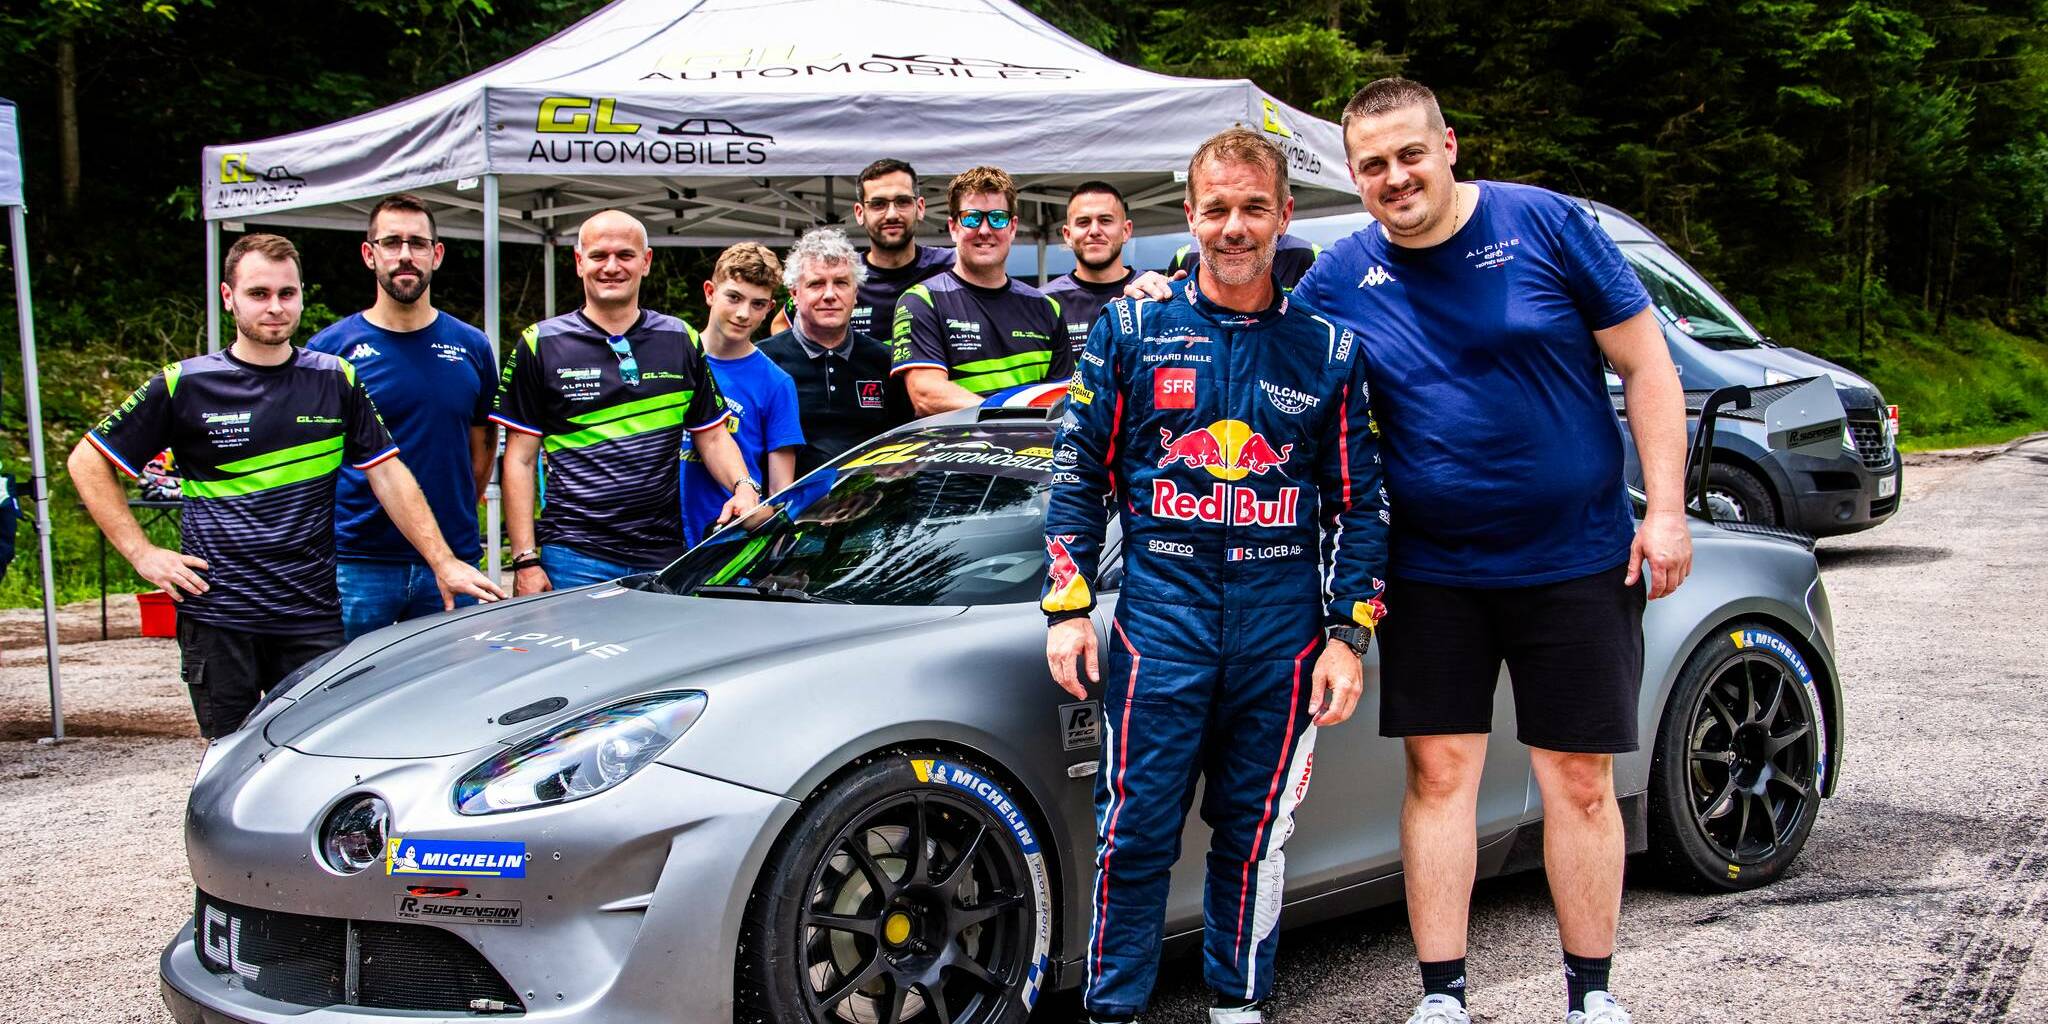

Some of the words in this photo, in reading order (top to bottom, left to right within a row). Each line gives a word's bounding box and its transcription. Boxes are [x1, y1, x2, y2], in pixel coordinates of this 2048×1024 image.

[639, 60, 1084, 81] AUTOMOBILES
[535, 96, 642, 134] GL
[1263, 98, 1291, 138] GL
[528, 139, 767, 165] AUTOMOBILES
[220, 152, 257, 184] GL
[1465, 238, 1520, 259] ALPINE
[950, 333, 981, 341] ALPINE
[430, 343, 467, 353] ALPINE
[1143, 352, 1182, 363] RICHARD
[1184, 354, 1212, 363] MILLE
[561, 382, 601, 390] ALPINE
[1068, 385, 1092, 399] ARDAHL
[1163, 379, 1194, 394] SFR
[1259, 379, 1320, 408] VULCANET
[208, 427, 251, 435] ALPINE
[1052, 472, 1080, 484] arco
[1152, 479, 1226, 523] Red
[1233, 487, 1300, 527] Bull
[1148, 539, 1194, 557] sparco
[1245, 549, 1256, 560] S.
[1258, 545, 1289, 559] LOEB
[457, 630, 630, 660] ALPINE
[1755, 632, 1809, 678] MICHELIN
[951, 769, 1034, 847] MICHELIN
[421, 852, 523, 868] MICHELIN
[1034, 863, 1047, 896] PILOT
[421, 904, 520, 918] SUSPENSION
[1040, 900, 1051, 943] SPORT
[204, 904, 262, 981] GL
